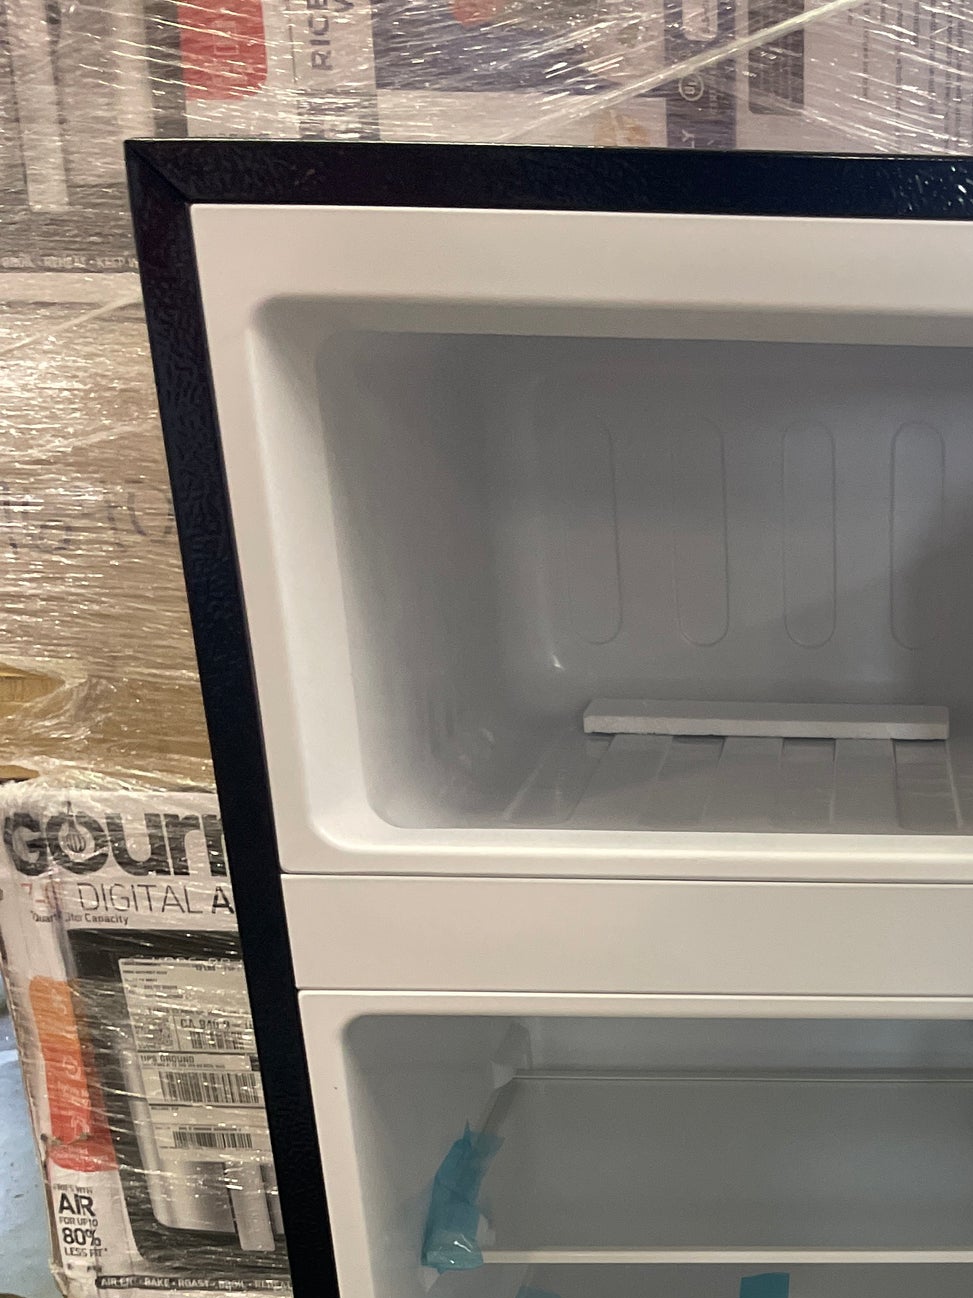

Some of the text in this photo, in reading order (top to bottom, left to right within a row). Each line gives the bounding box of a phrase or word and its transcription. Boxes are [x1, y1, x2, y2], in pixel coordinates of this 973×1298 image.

[77, 883, 203, 914] DIGITAL
[85, 913, 129, 925] Capacity
[59, 1193, 96, 1216] AIR
[62, 1227, 102, 1247] 80%
